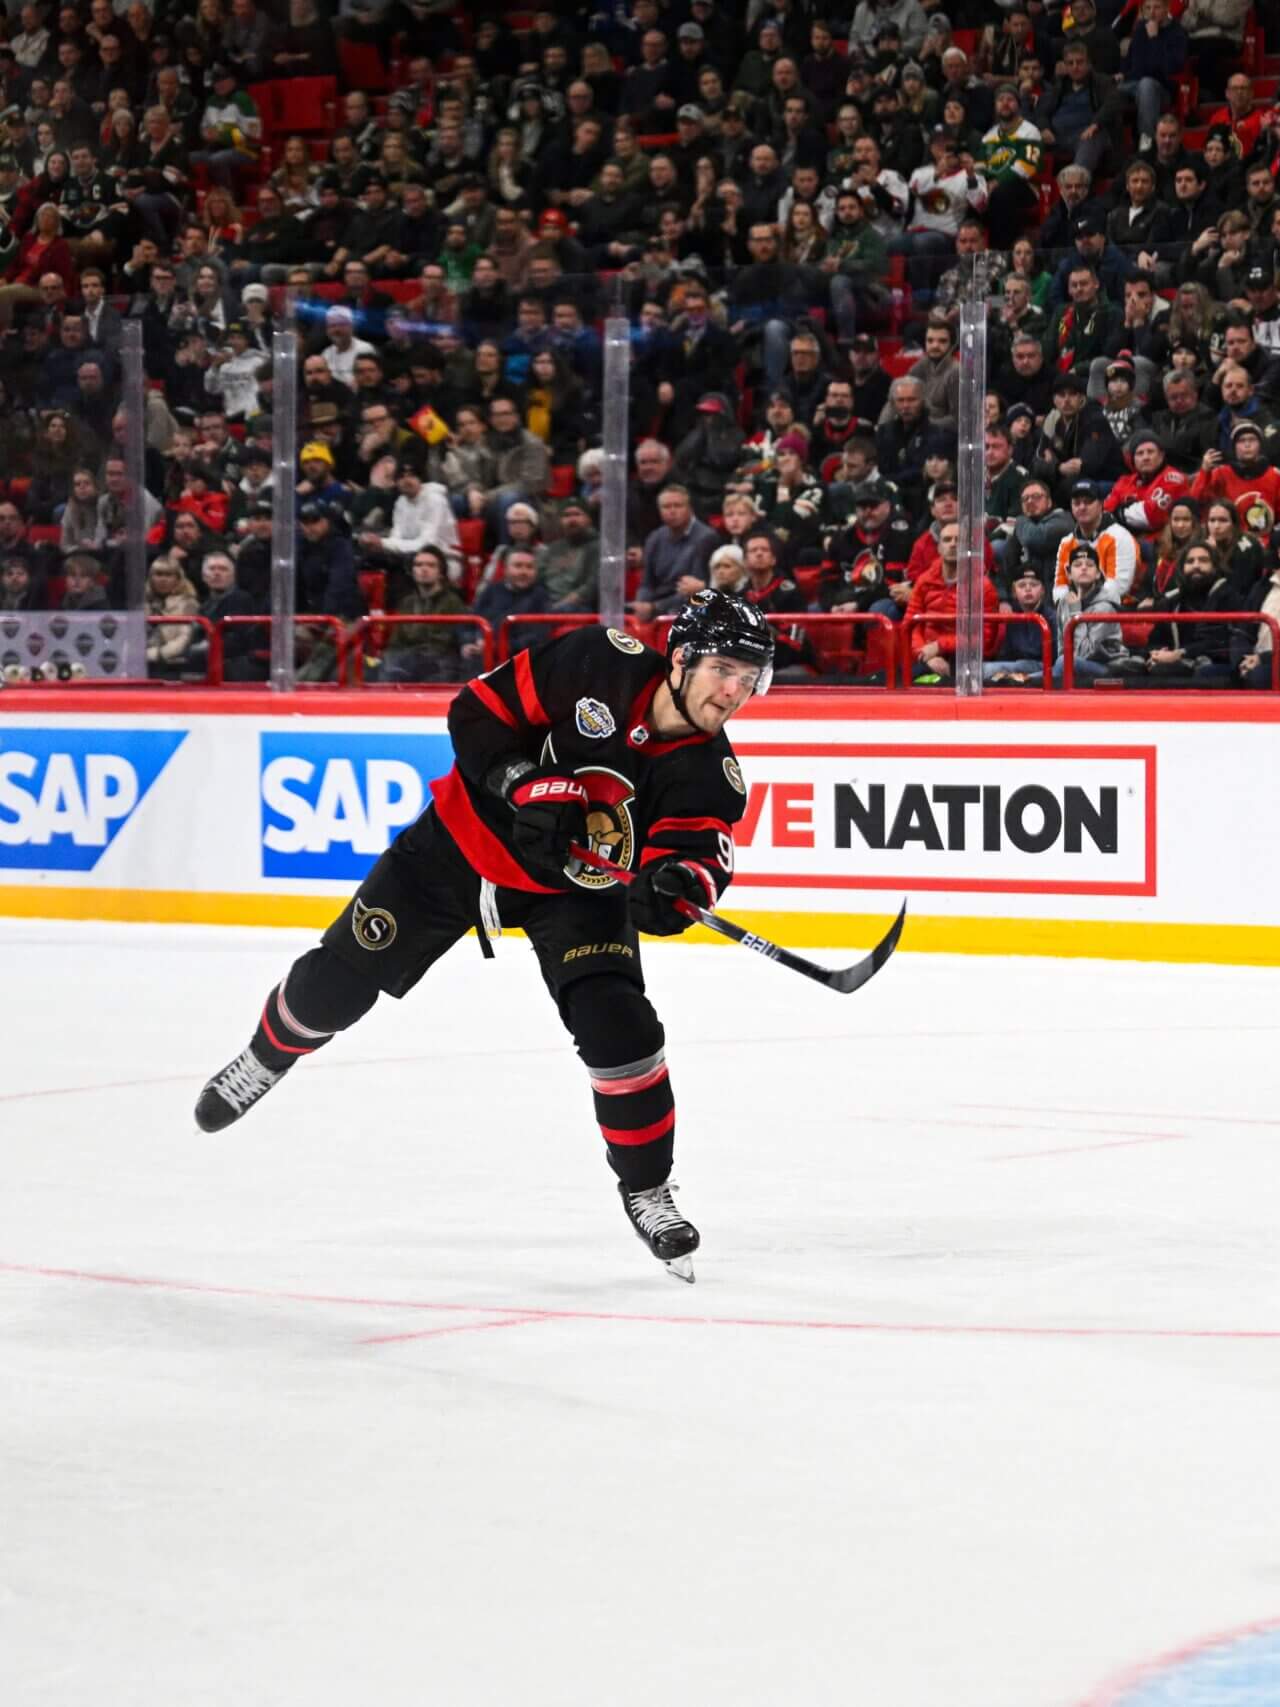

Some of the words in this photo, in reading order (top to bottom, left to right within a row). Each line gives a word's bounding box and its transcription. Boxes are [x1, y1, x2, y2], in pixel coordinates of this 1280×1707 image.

[0, 751, 139, 846] SAP
[261, 756, 423, 854] SAP
[731, 783, 814, 848] VE
[834, 783, 1118, 854] NATION
[716, 831, 734, 873] 9
[562, 943, 633, 963] BAUER
[741, 931, 783, 961] BAU
